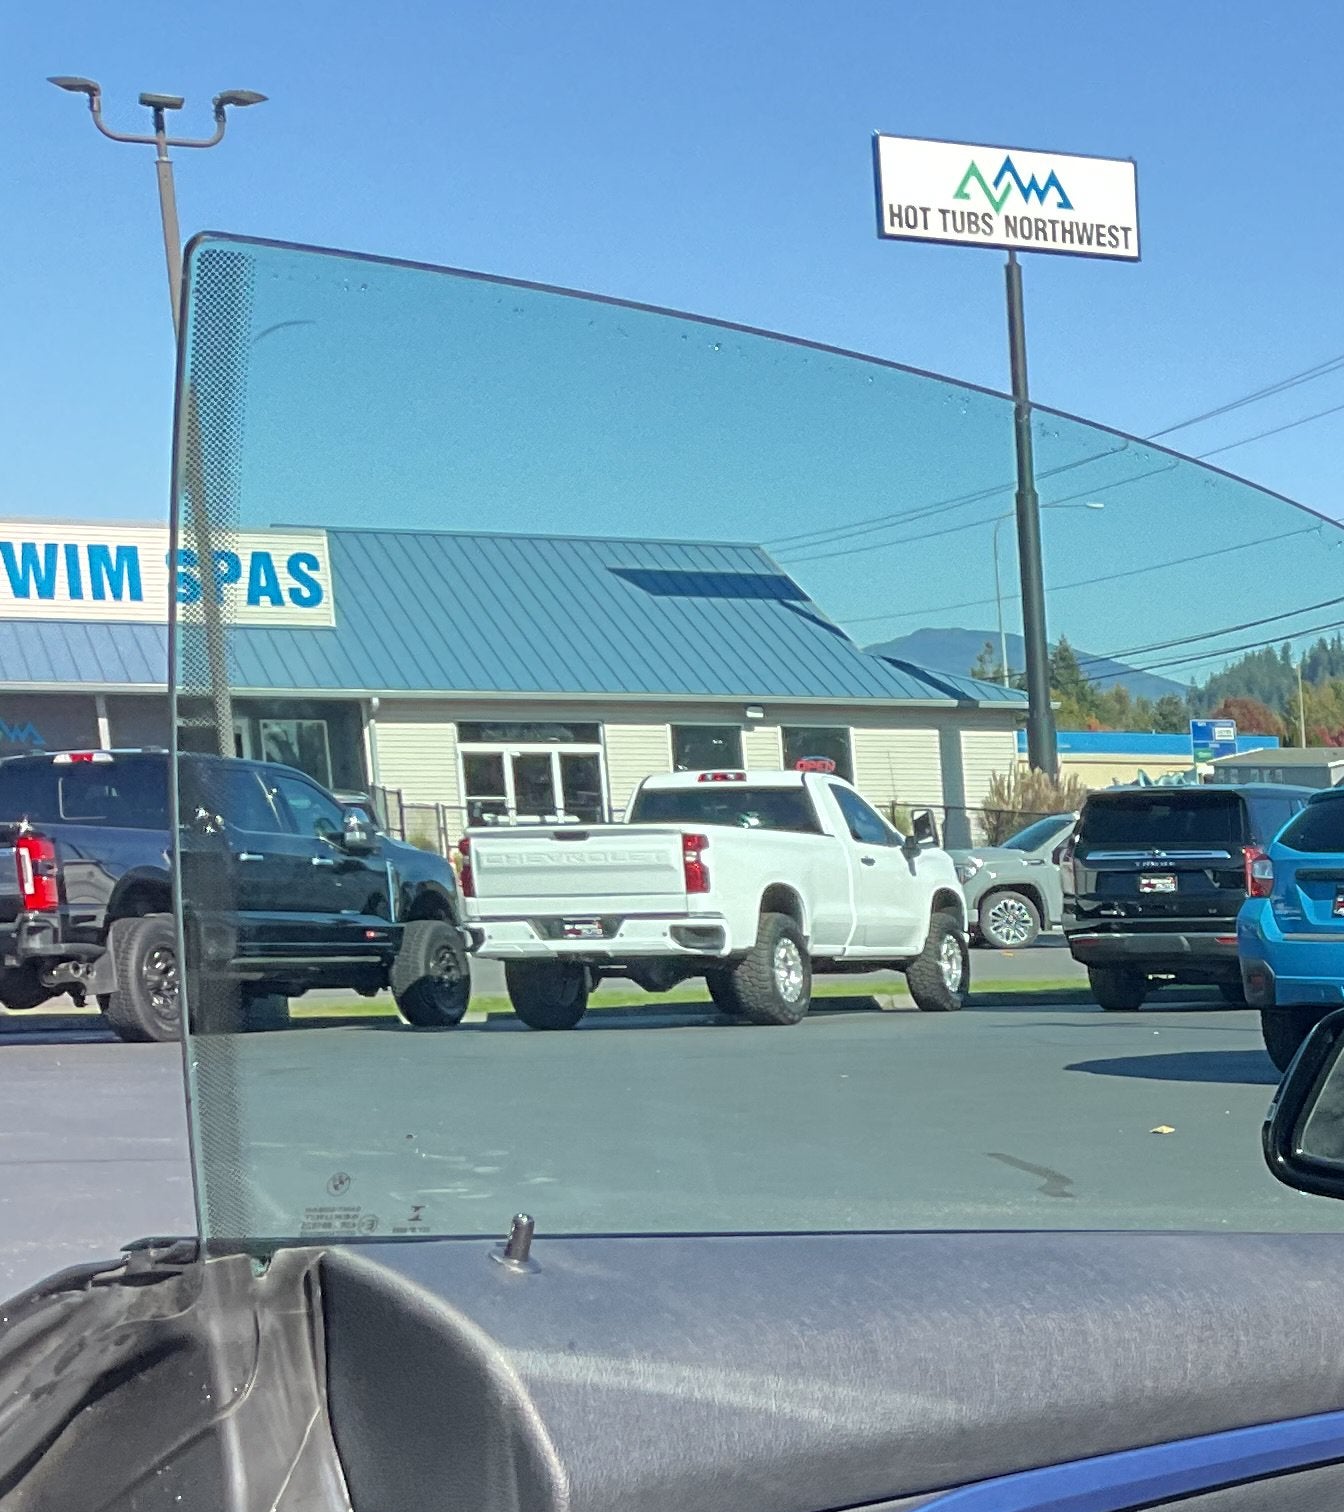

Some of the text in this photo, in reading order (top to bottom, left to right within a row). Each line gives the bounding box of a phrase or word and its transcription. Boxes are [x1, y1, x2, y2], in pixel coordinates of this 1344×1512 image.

[888, 204, 1133, 250] HOT TUBS NORTHWEST
[0, 541, 143, 602] WIM
